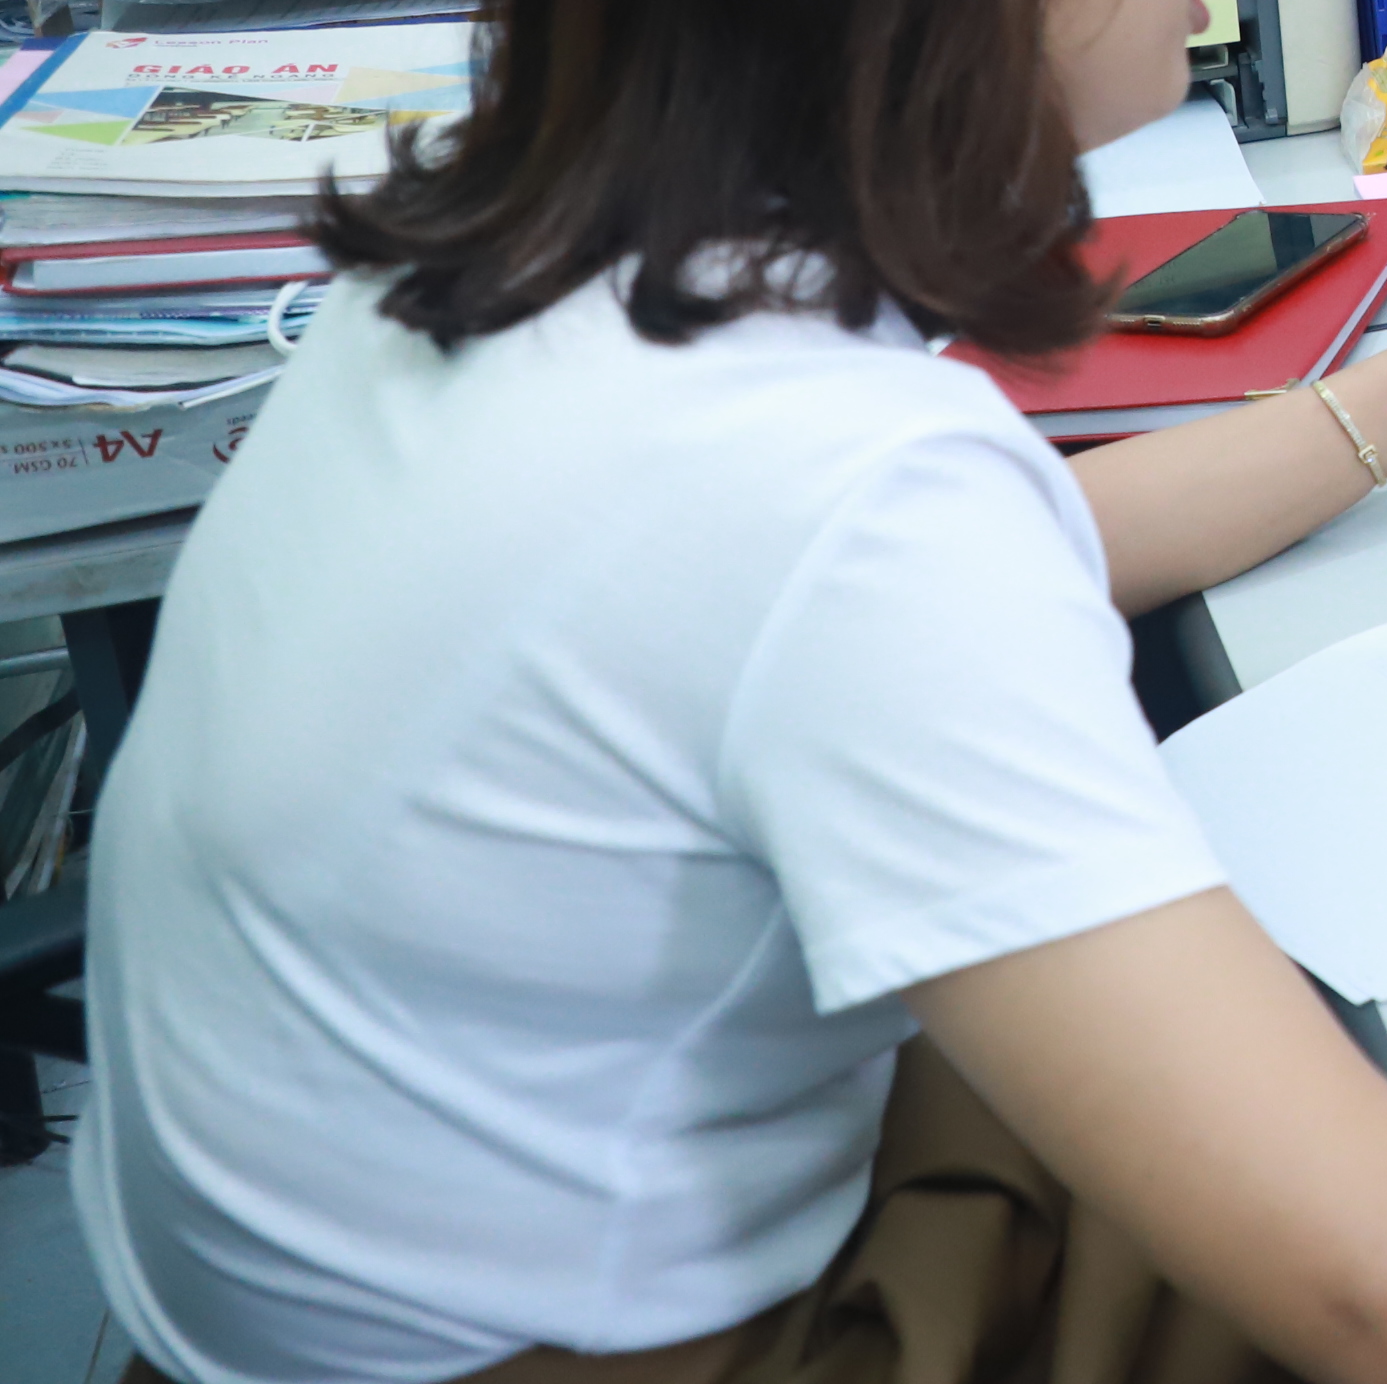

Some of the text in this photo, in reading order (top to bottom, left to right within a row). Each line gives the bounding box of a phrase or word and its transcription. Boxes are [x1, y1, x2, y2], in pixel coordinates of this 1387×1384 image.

[132, 62, 339, 75] GIÁO ÁN
[93, 427, 164, 463] A4
[13, 456, 79, 475] 70 GSM
